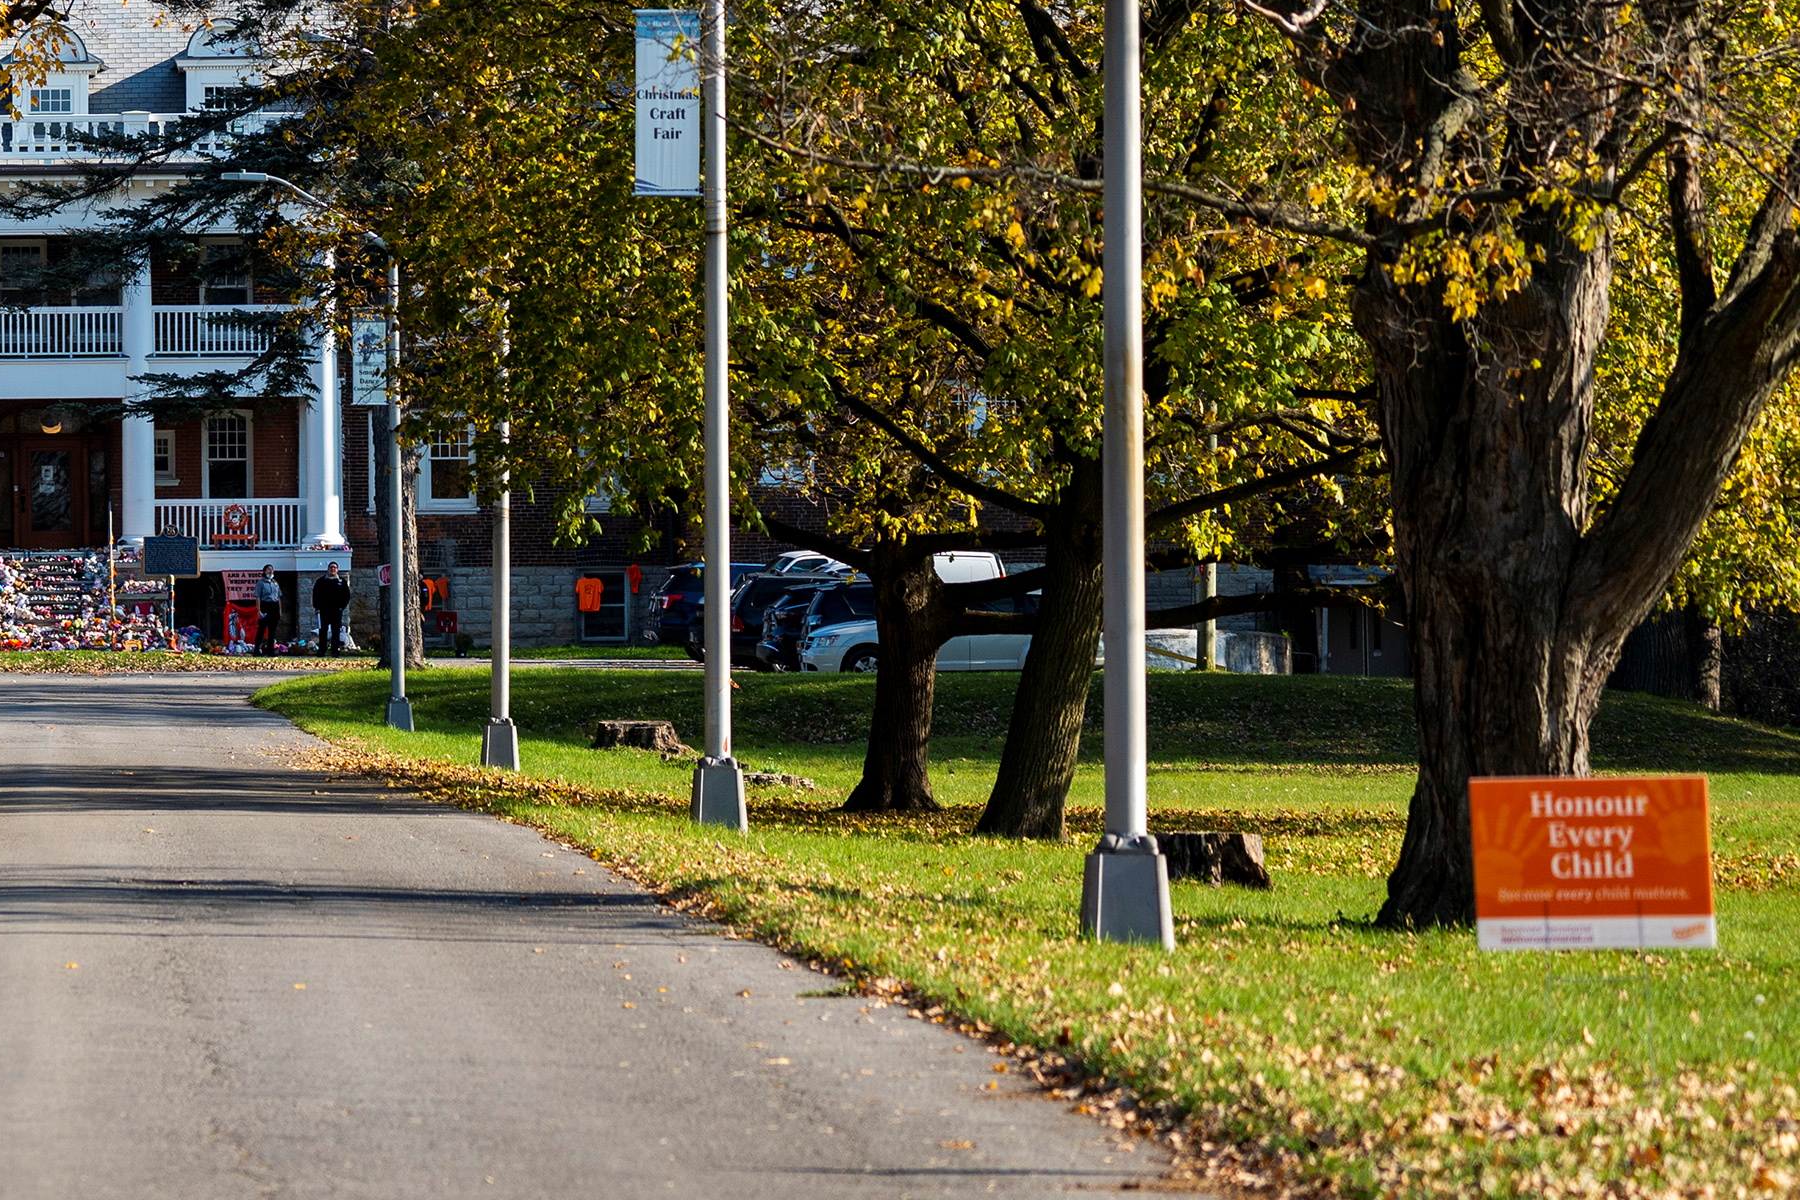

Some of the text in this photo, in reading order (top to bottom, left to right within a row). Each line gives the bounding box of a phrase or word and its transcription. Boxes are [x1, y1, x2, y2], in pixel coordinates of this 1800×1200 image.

[636, 89, 699, 100] Christmas
[650, 107, 686, 120] Craft
[653, 127, 682, 139] Fair
[1530, 790, 1649, 818] Honour
[1548, 821, 1634, 853] Every
[1550, 850, 1635, 879] Child
[1555, 889, 1593, 903] every
